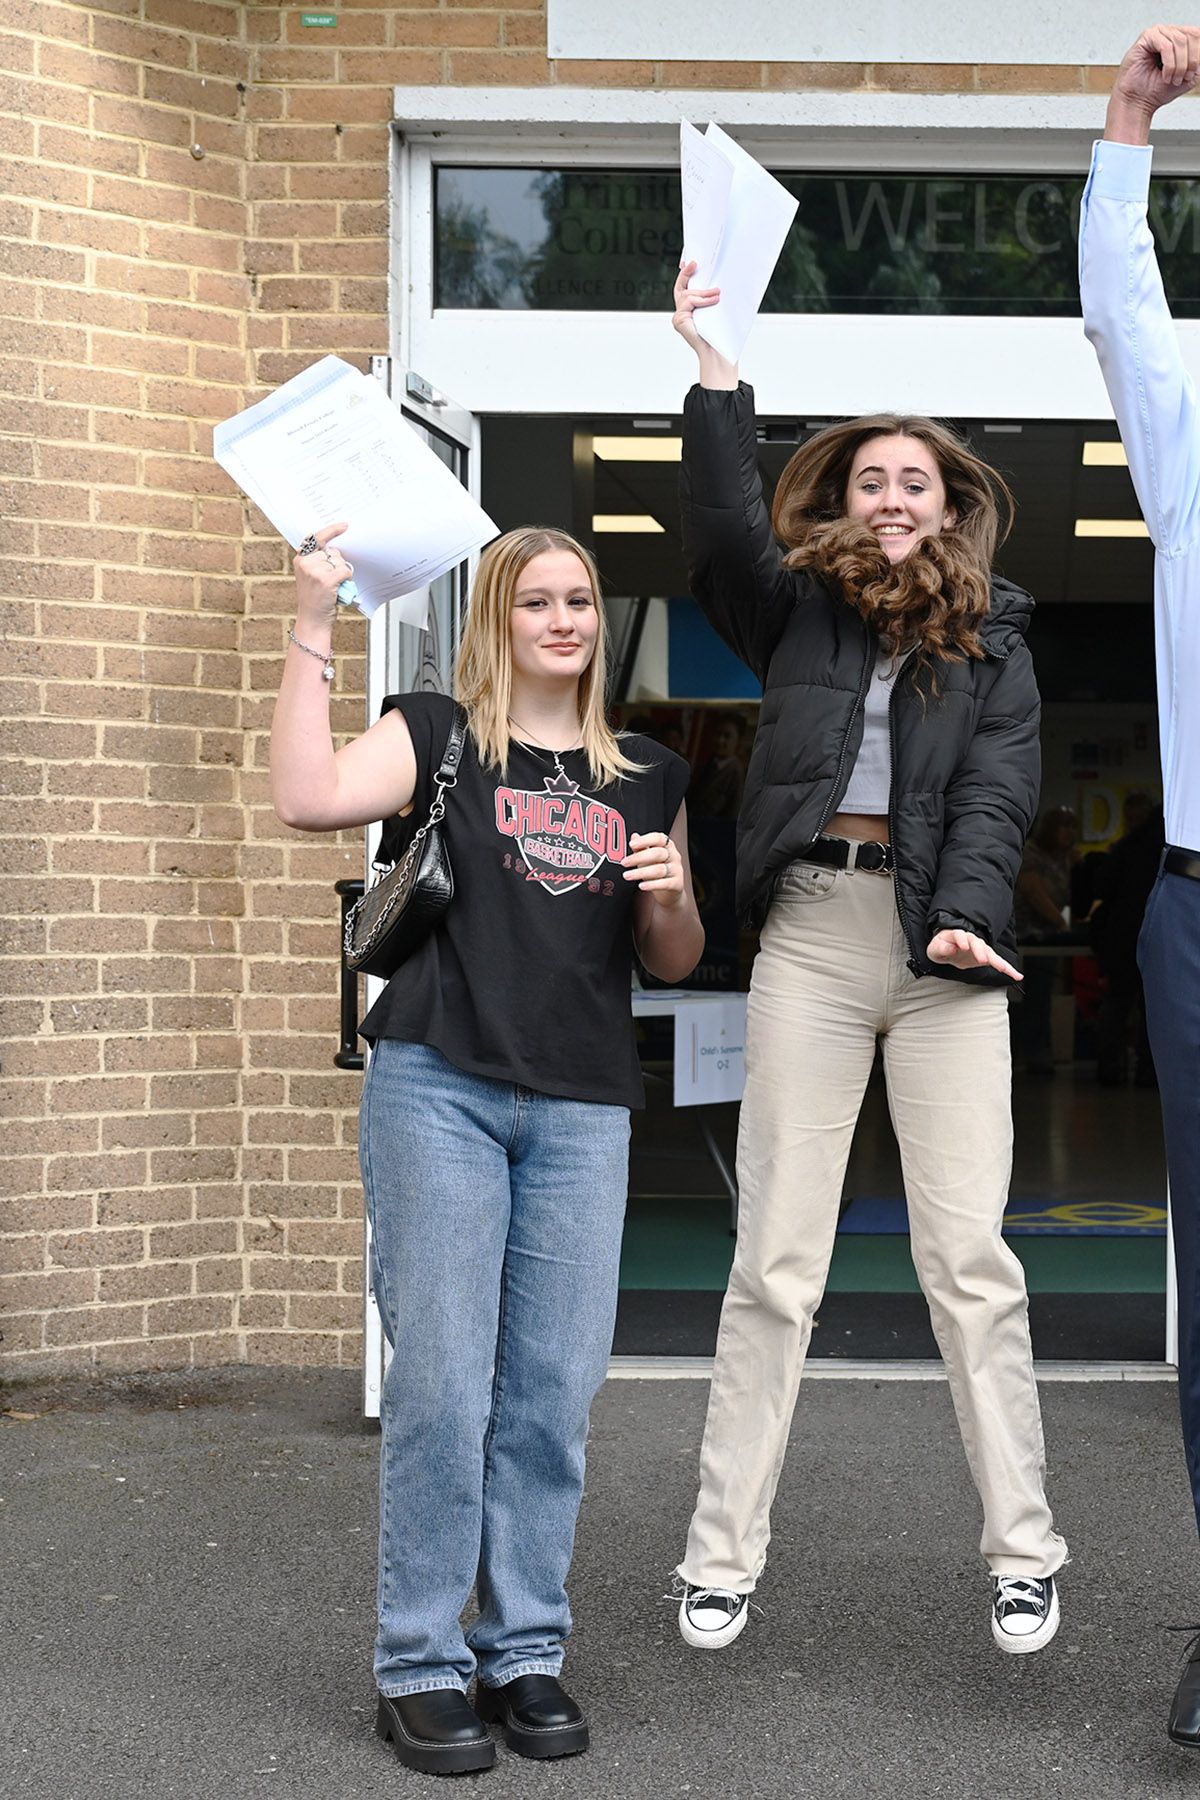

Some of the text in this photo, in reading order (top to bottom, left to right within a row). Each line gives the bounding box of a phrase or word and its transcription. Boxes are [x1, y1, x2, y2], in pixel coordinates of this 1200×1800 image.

[559, 173, 682, 211] Trinit
[556, 215, 682, 258] Colleg
[494, 786, 627, 865] CHICAGO
[524, 837, 594, 869] BASKETBALL
[526, 867, 588, 885] League
